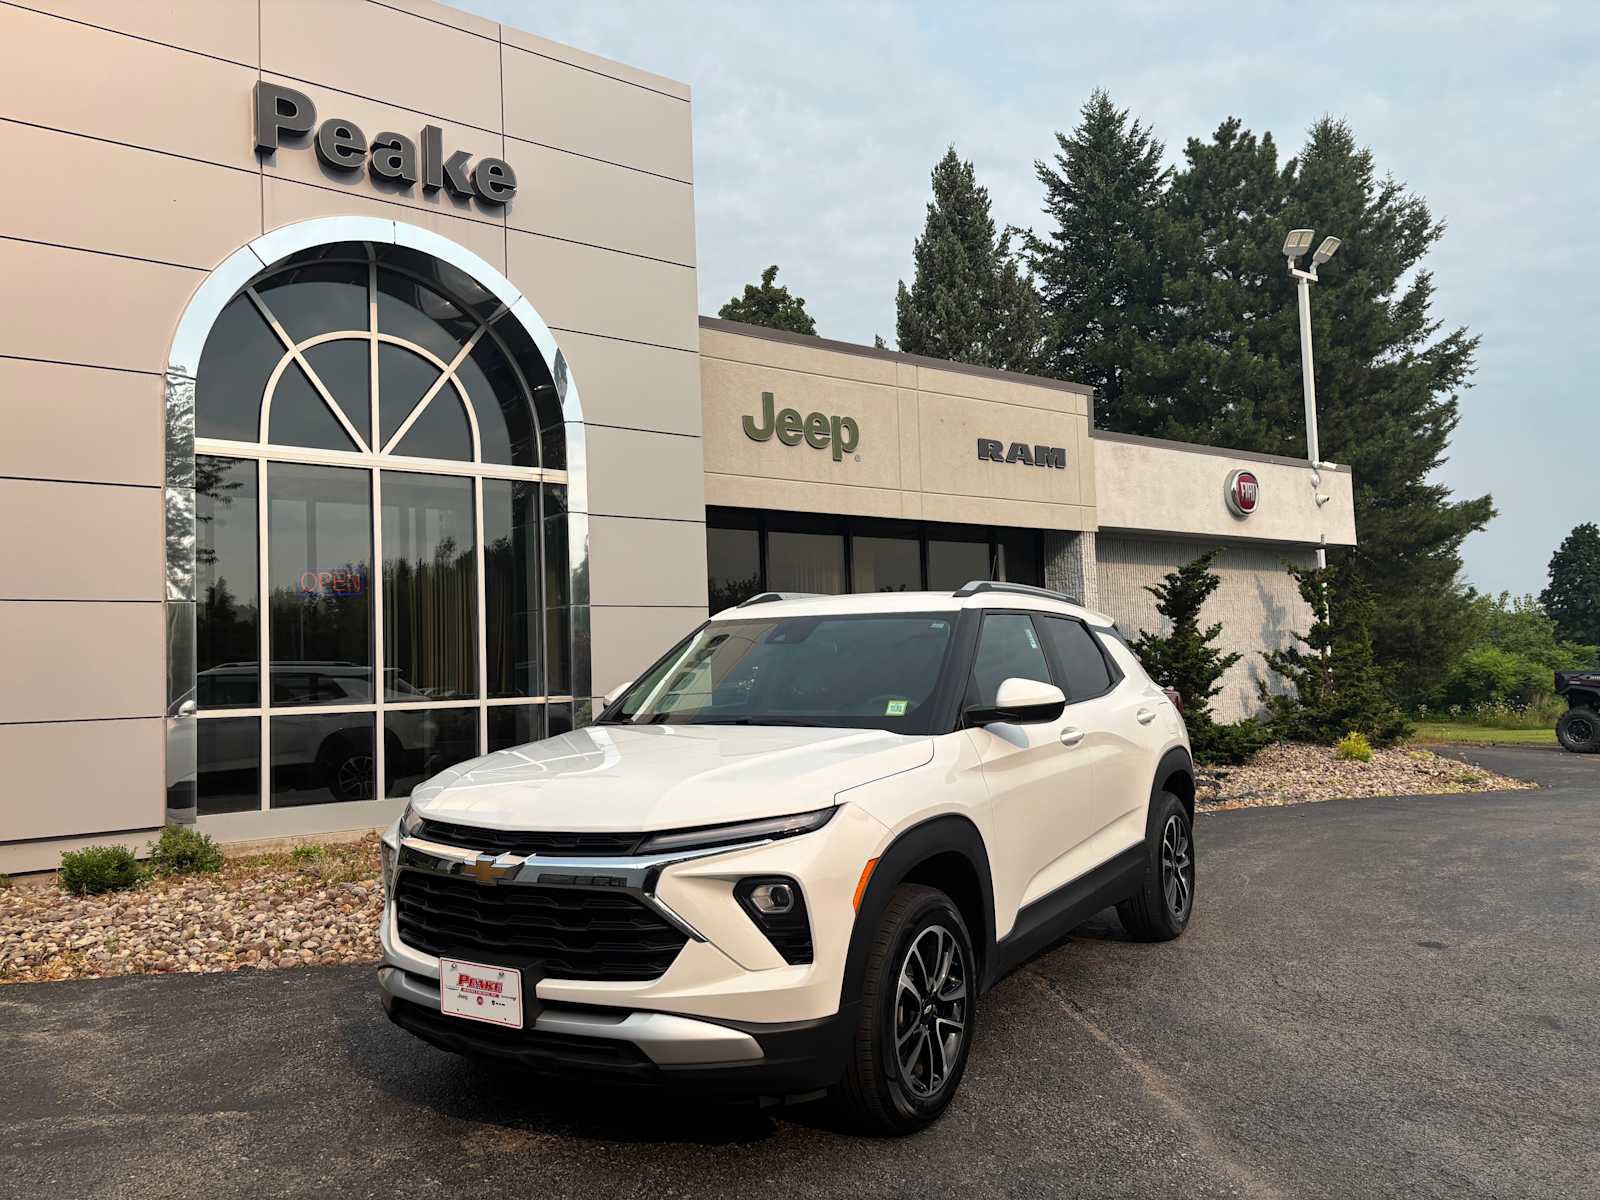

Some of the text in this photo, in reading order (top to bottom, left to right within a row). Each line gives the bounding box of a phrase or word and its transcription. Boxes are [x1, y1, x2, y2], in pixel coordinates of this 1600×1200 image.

[253, 80, 517, 205] Peake
[742, 392, 860, 461] Jeep
[977, 438, 1066, 469] RAM
[1240, 481, 1257, 501] FIAT
[301, 571, 360, 593] OPEN
